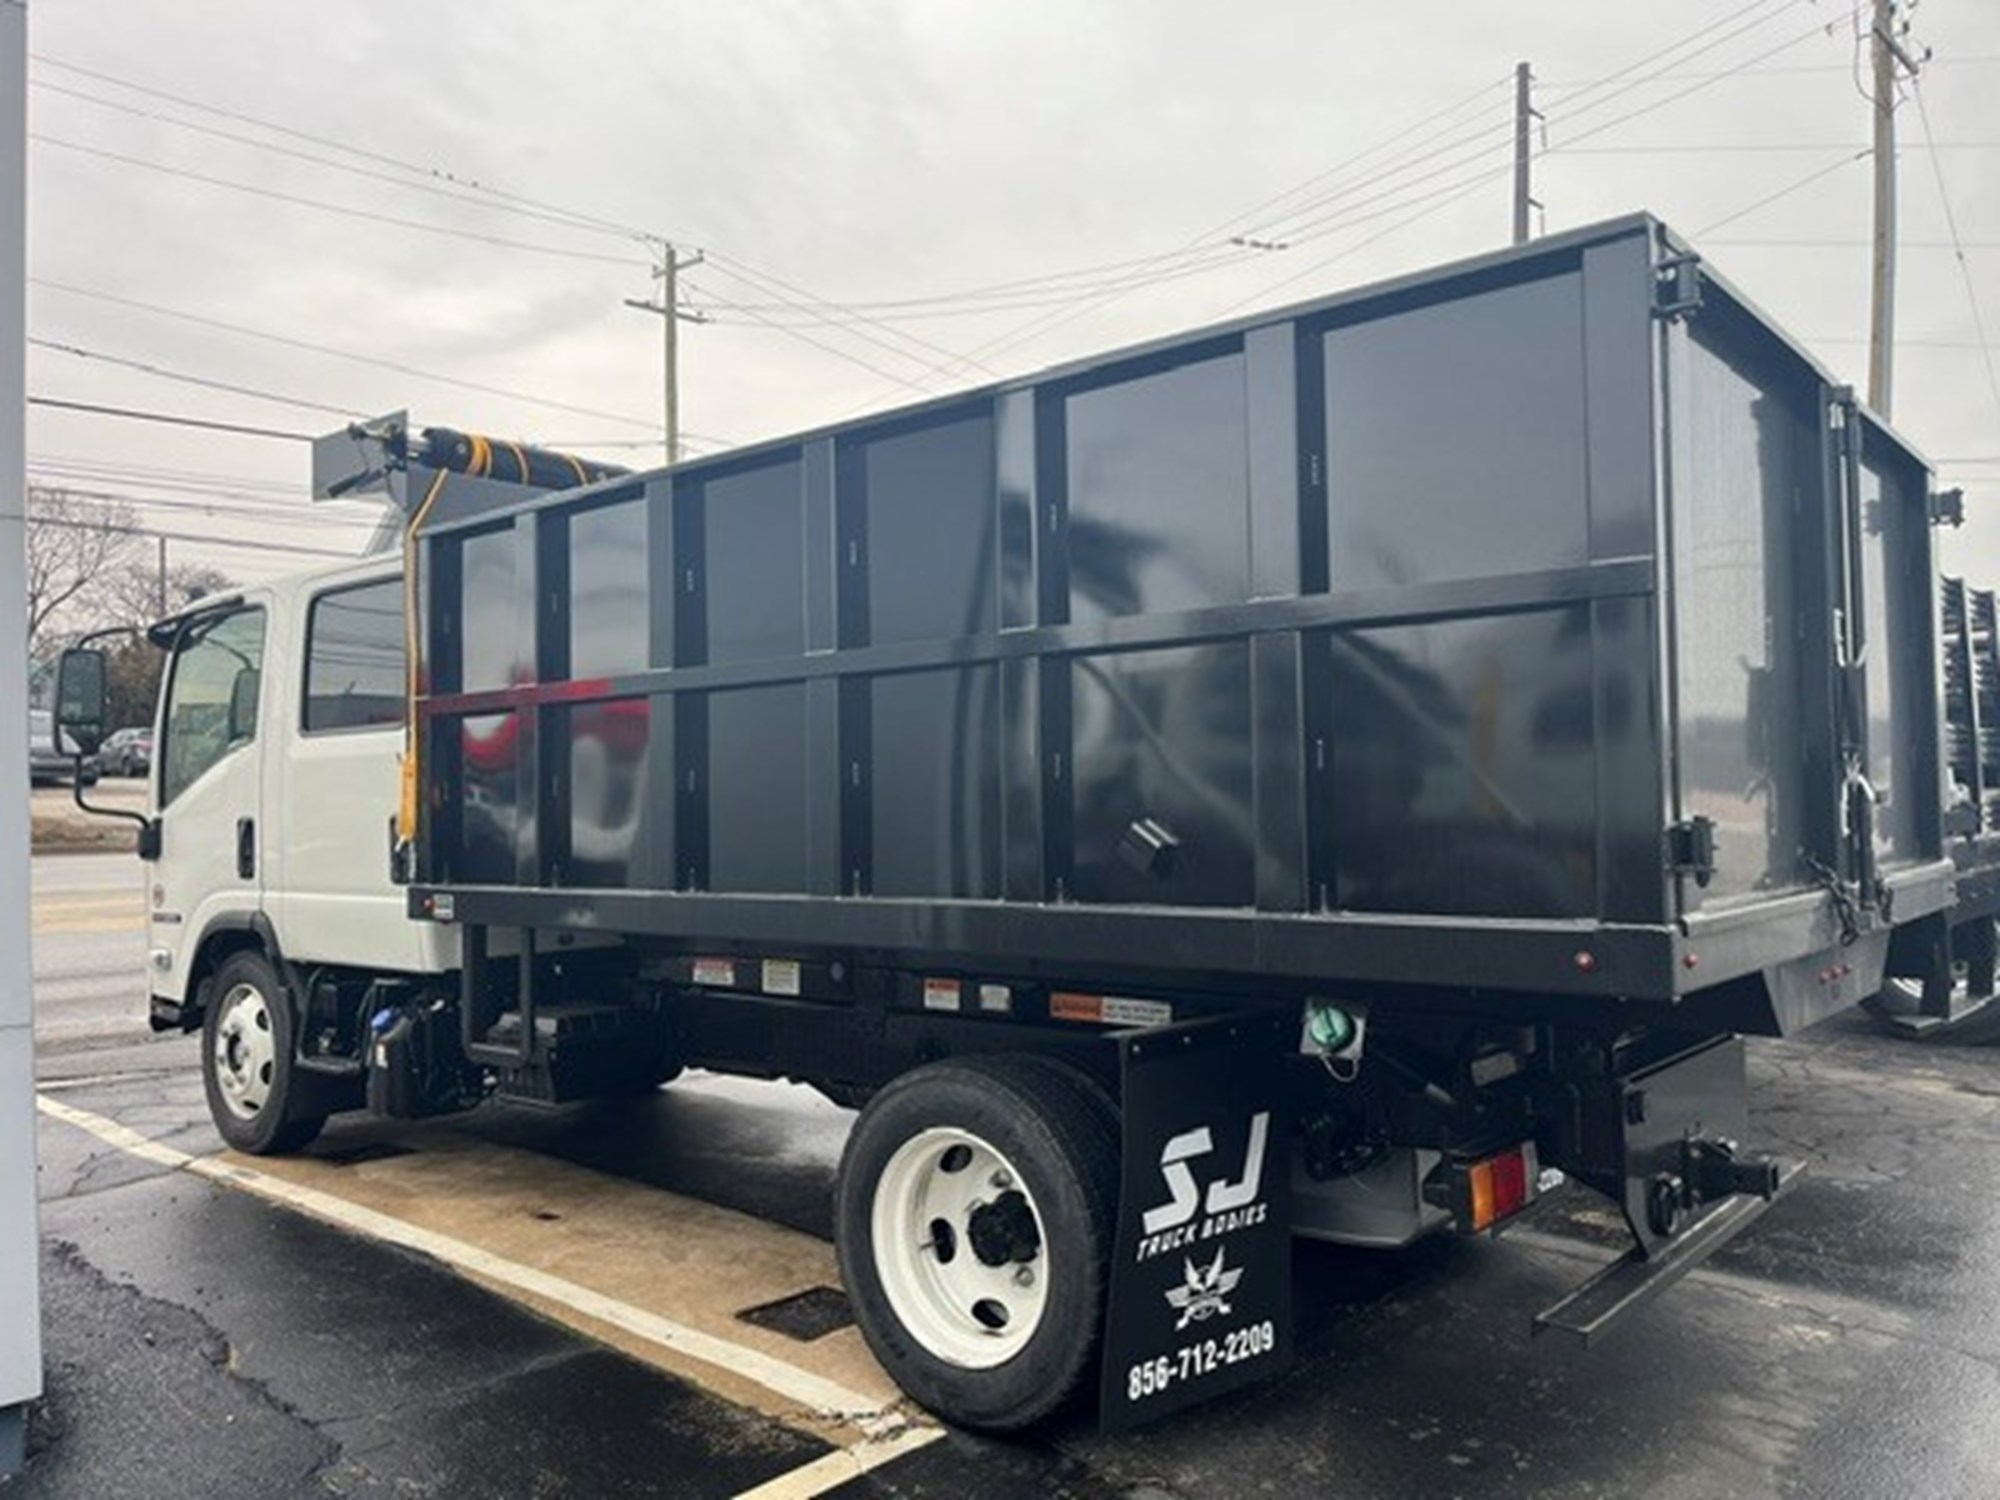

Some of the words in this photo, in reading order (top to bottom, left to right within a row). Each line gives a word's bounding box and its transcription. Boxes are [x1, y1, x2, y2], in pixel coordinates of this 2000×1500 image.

[1142, 1111, 1269, 1235] SJ
[1136, 1223, 1197, 1262] TRUCK
[1200, 1203, 1267, 1239] BODIES
[1127, 1320, 1275, 1401] 856-712-2209
